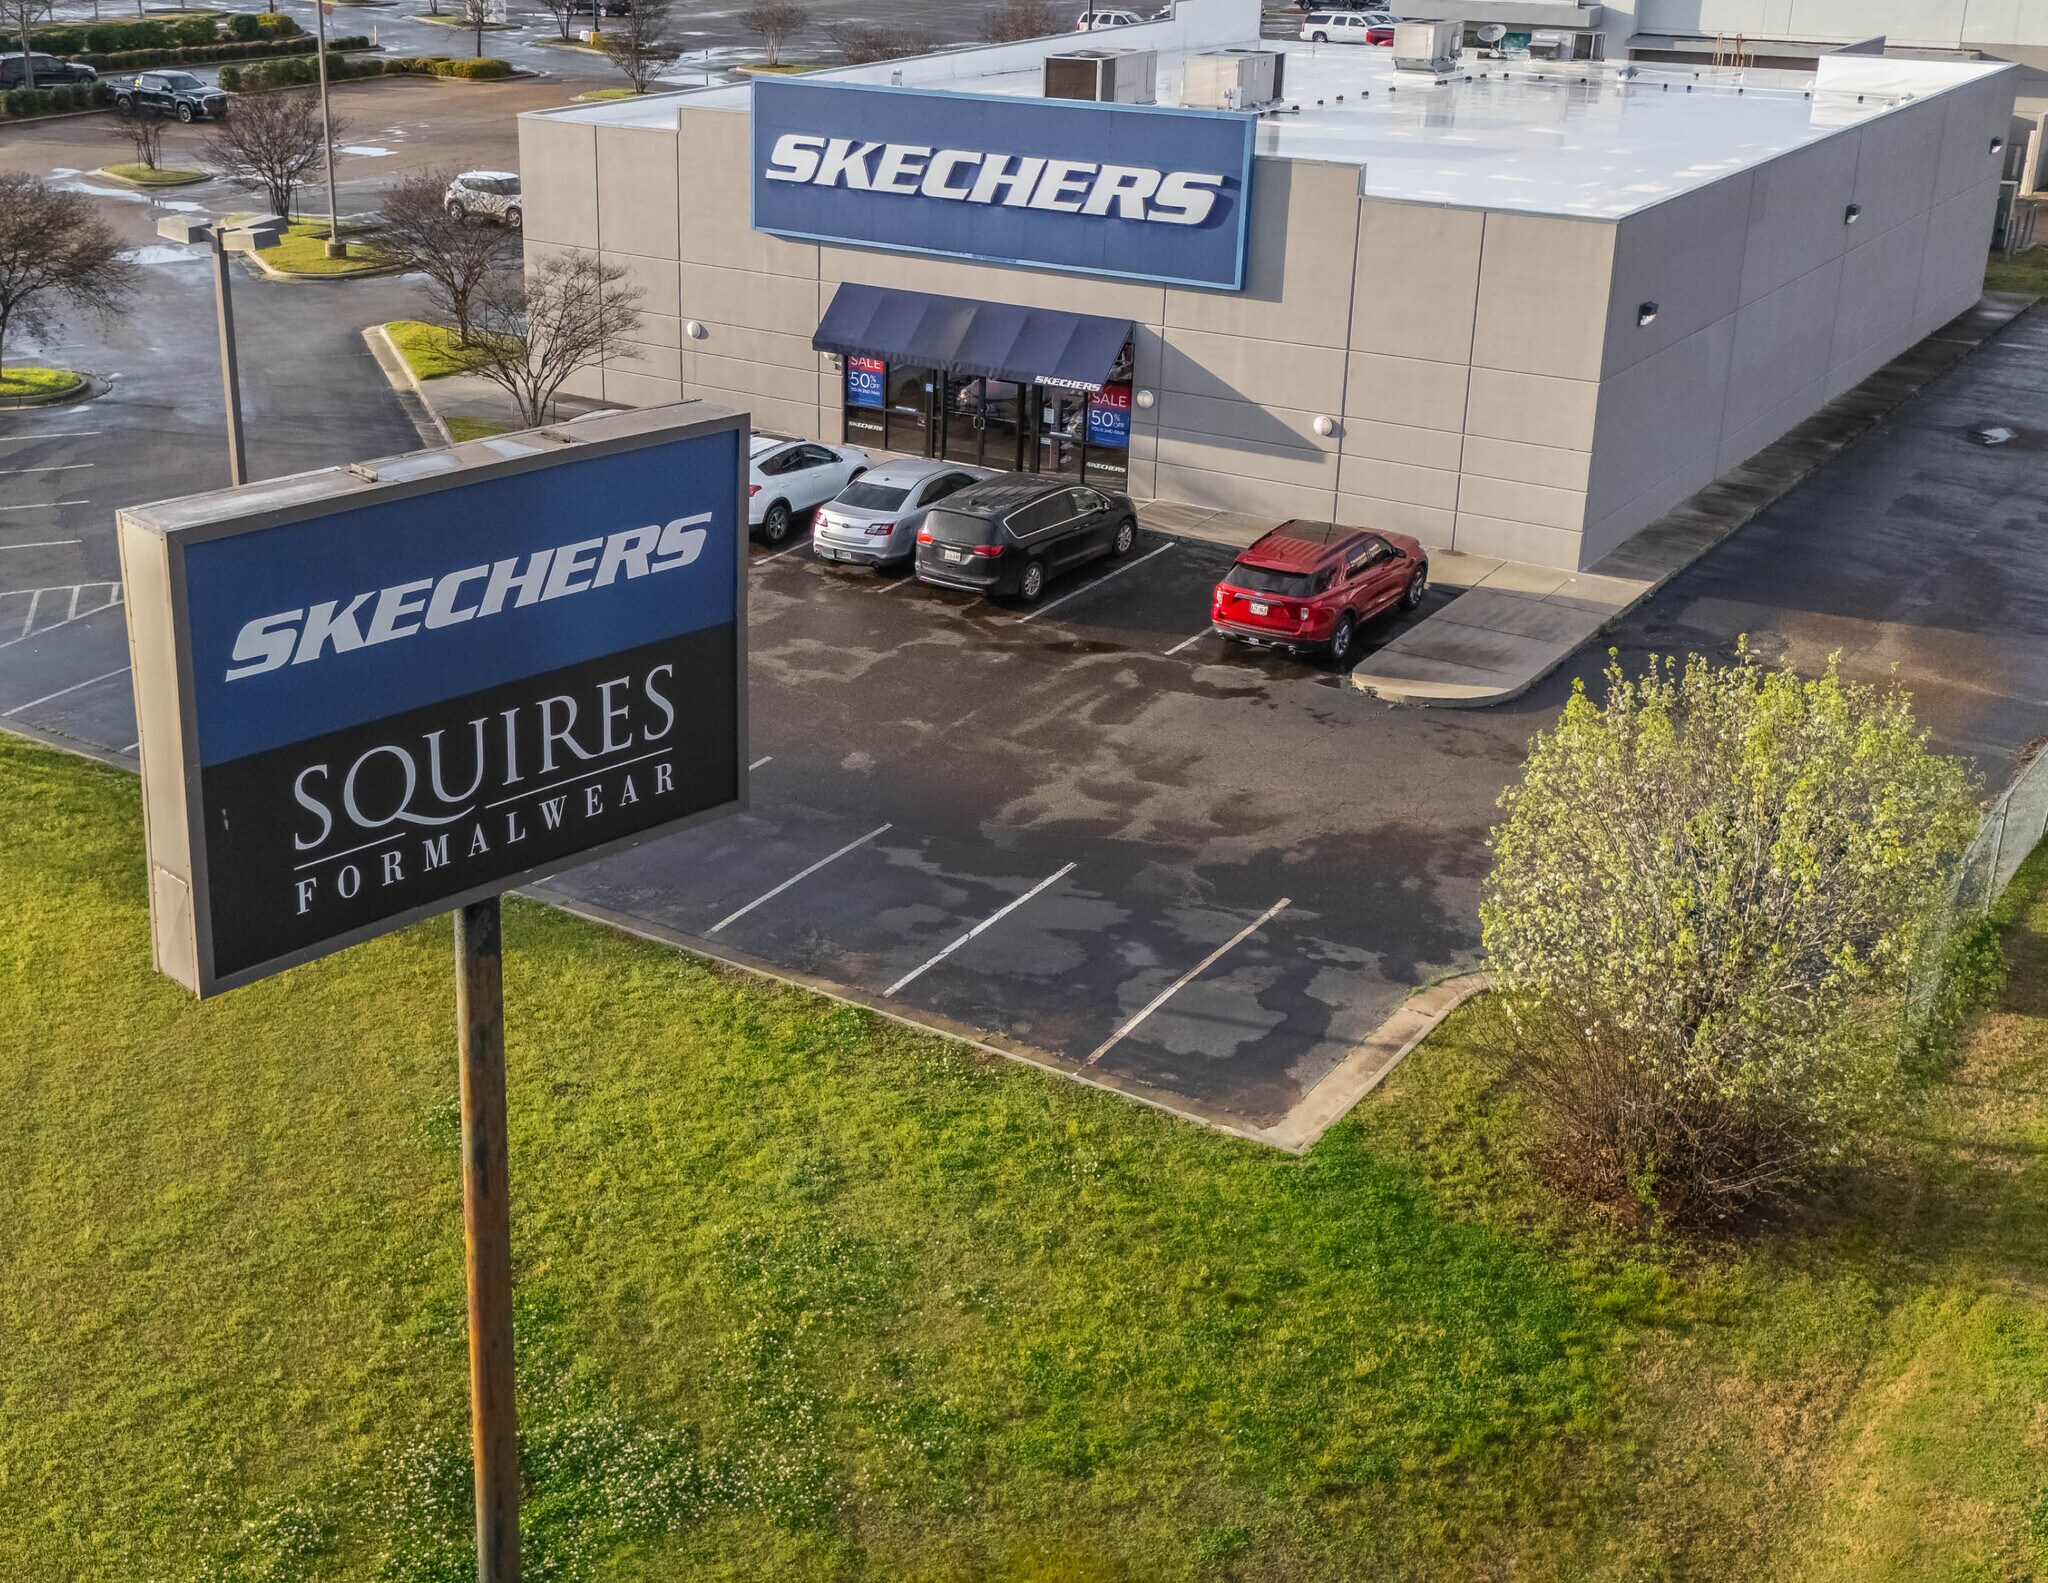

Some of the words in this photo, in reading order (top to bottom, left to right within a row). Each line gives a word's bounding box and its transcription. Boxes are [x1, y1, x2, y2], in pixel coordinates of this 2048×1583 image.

[765, 133, 1224, 226] SKECHERS
[851, 356, 881, 369] SALE
[1034, 375, 1101, 391] SKECHERS
[1092, 392, 1127, 407] SALE
[848, 421, 883, 431] SKECHERS
[1087, 462, 1126, 472] SKECHERS
[226, 512, 713, 682] SKECHERS
[294, 664, 675, 851] SQUIRES
[296, 763, 675, 916] FORMALWEAR
